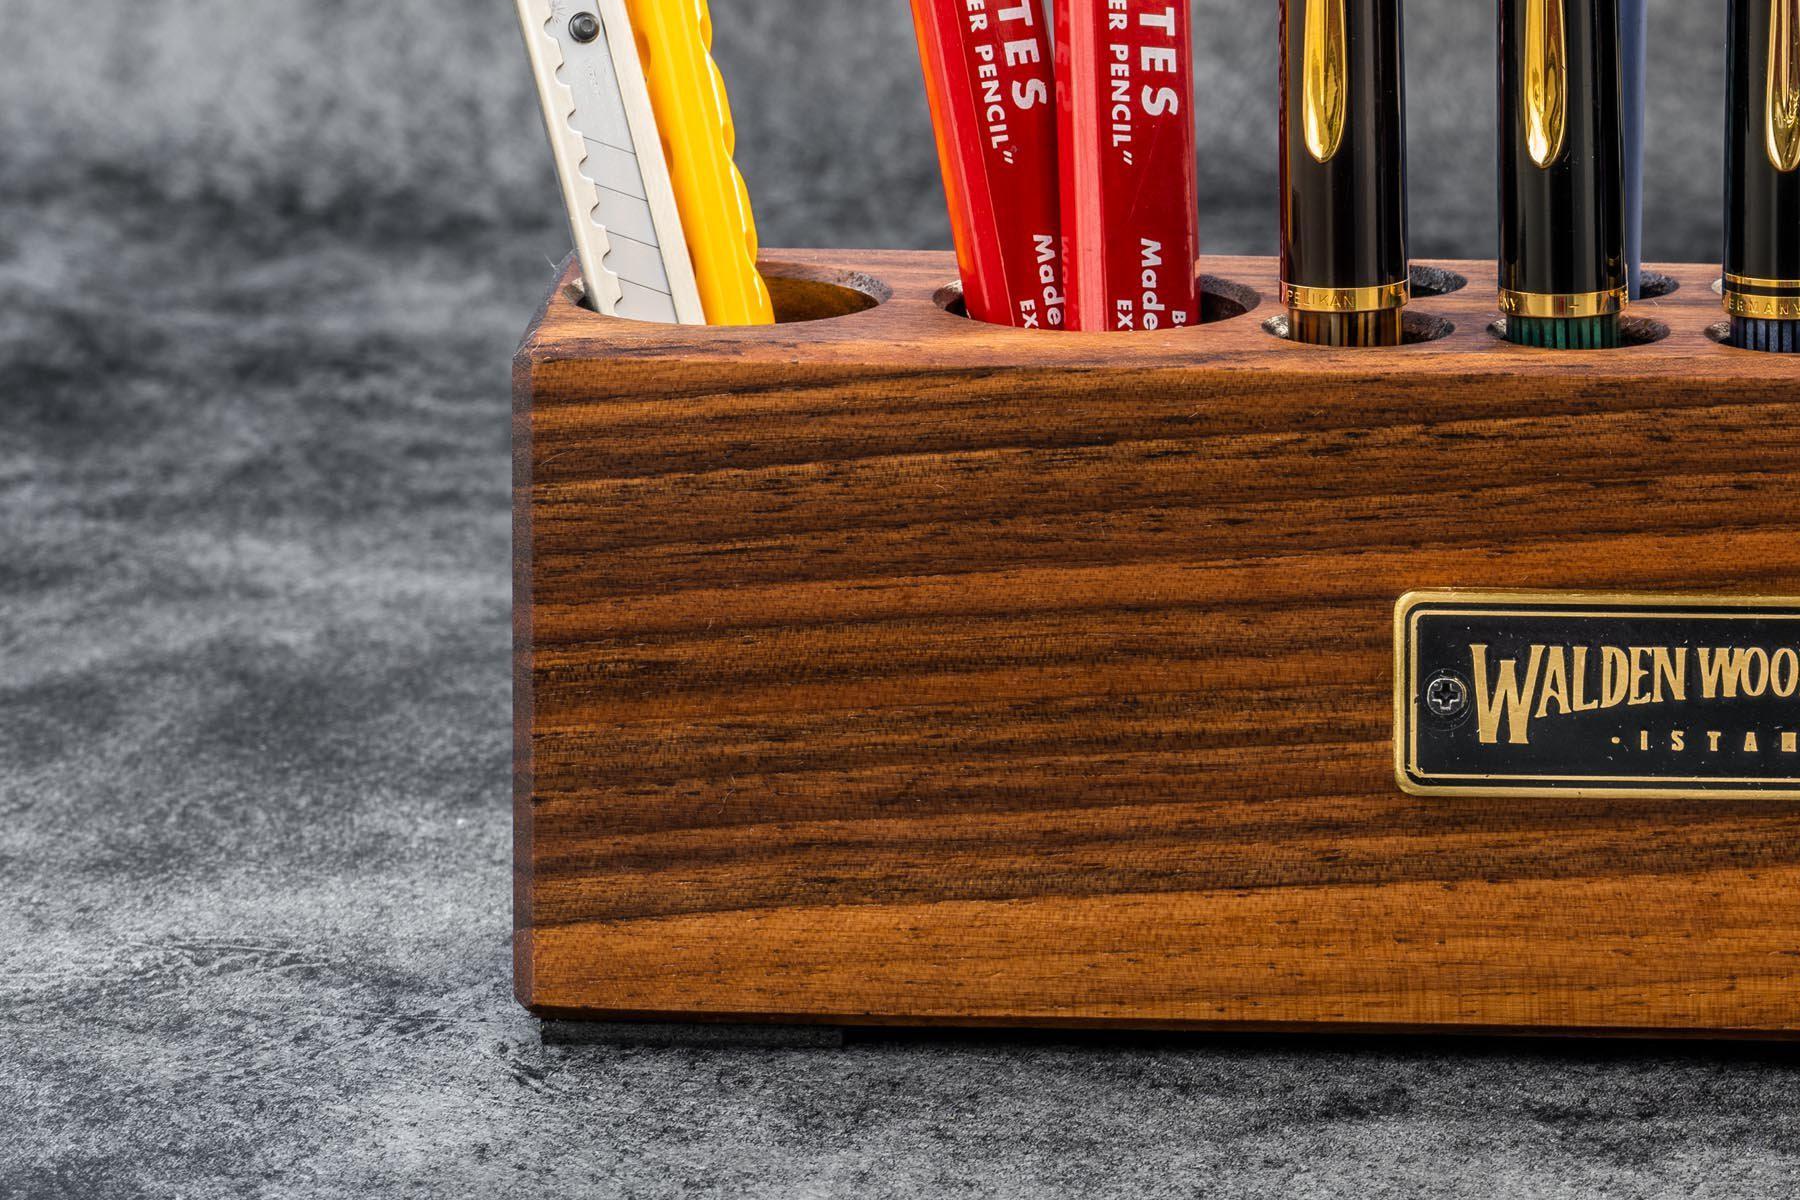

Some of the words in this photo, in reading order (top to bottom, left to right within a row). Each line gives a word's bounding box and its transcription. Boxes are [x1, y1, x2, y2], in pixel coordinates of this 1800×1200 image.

[1032, 234, 1065, 326] Made
[1140, 237, 1165, 330] Made
[1287, 289, 1355, 308] PELIKAN
[1019, 299, 1040, 329] EX
[1116, 299, 1134, 331] EX
[1468, 642, 1688, 745] WALDEN
